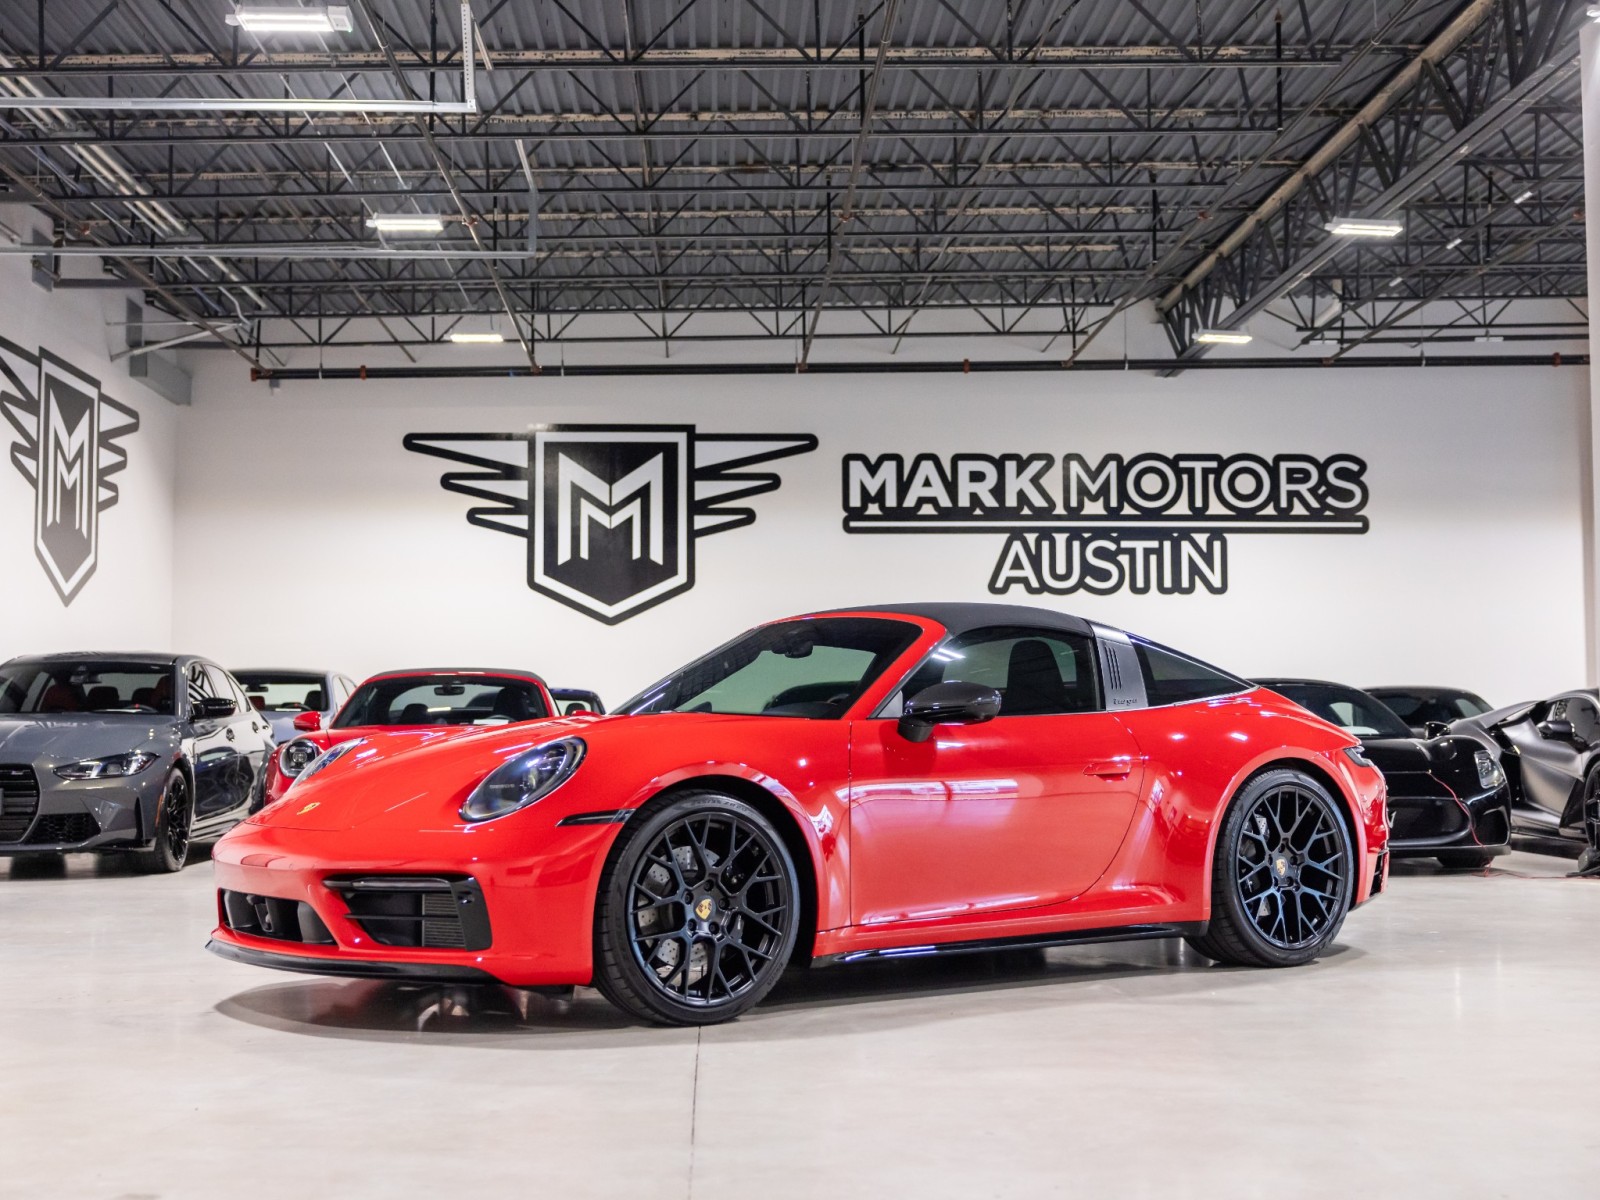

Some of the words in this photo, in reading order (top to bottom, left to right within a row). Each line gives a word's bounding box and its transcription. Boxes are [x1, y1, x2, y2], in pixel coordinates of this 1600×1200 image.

[847, 458, 1051, 509] MARK
[1068, 458, 1364, 510] MOTORS
[993, 538, 1224, 591] AUSTIN
